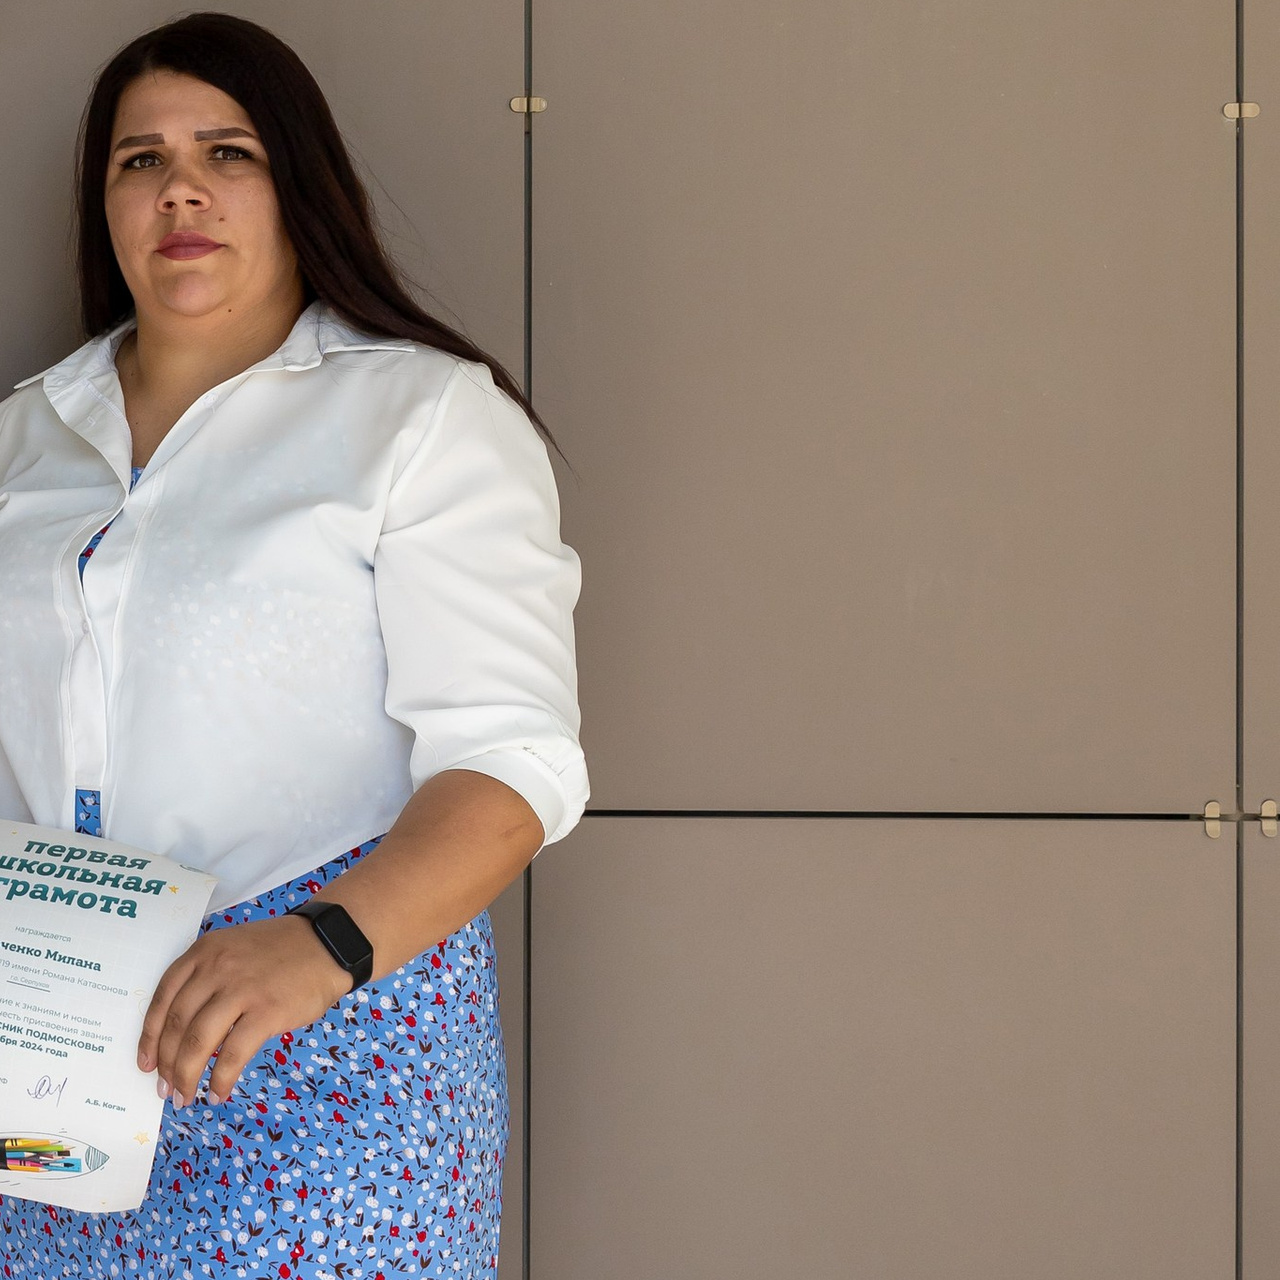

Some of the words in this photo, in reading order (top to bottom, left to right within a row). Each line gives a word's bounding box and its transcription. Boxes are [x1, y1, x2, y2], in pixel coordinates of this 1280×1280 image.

[24, 840, 151, 870] первая
[14, 925, 72, 943] награждается
[44, 949, 102, 972] Милана
[11, 963, 41, 975] имени
[42, 969, 75, 984] Романа
[76, 978, 129, 997] Катасонова
[22, 1002, 61, 1017] знаниям
[70, 1015, 102, 1028] новым
[23, 1016, 79, 1035] присвоения
[80, 1029, 113, 1043] звания
[25, 1028, 105, 1054] ПОДМОСКОВЬЯ
[19, 1040, 43, 1053] 2024
[44, 1047, 69, 1059] года
[84, 1097, 101, 1108] А.Б.
[102, 1101, 126, 1113] Коган
